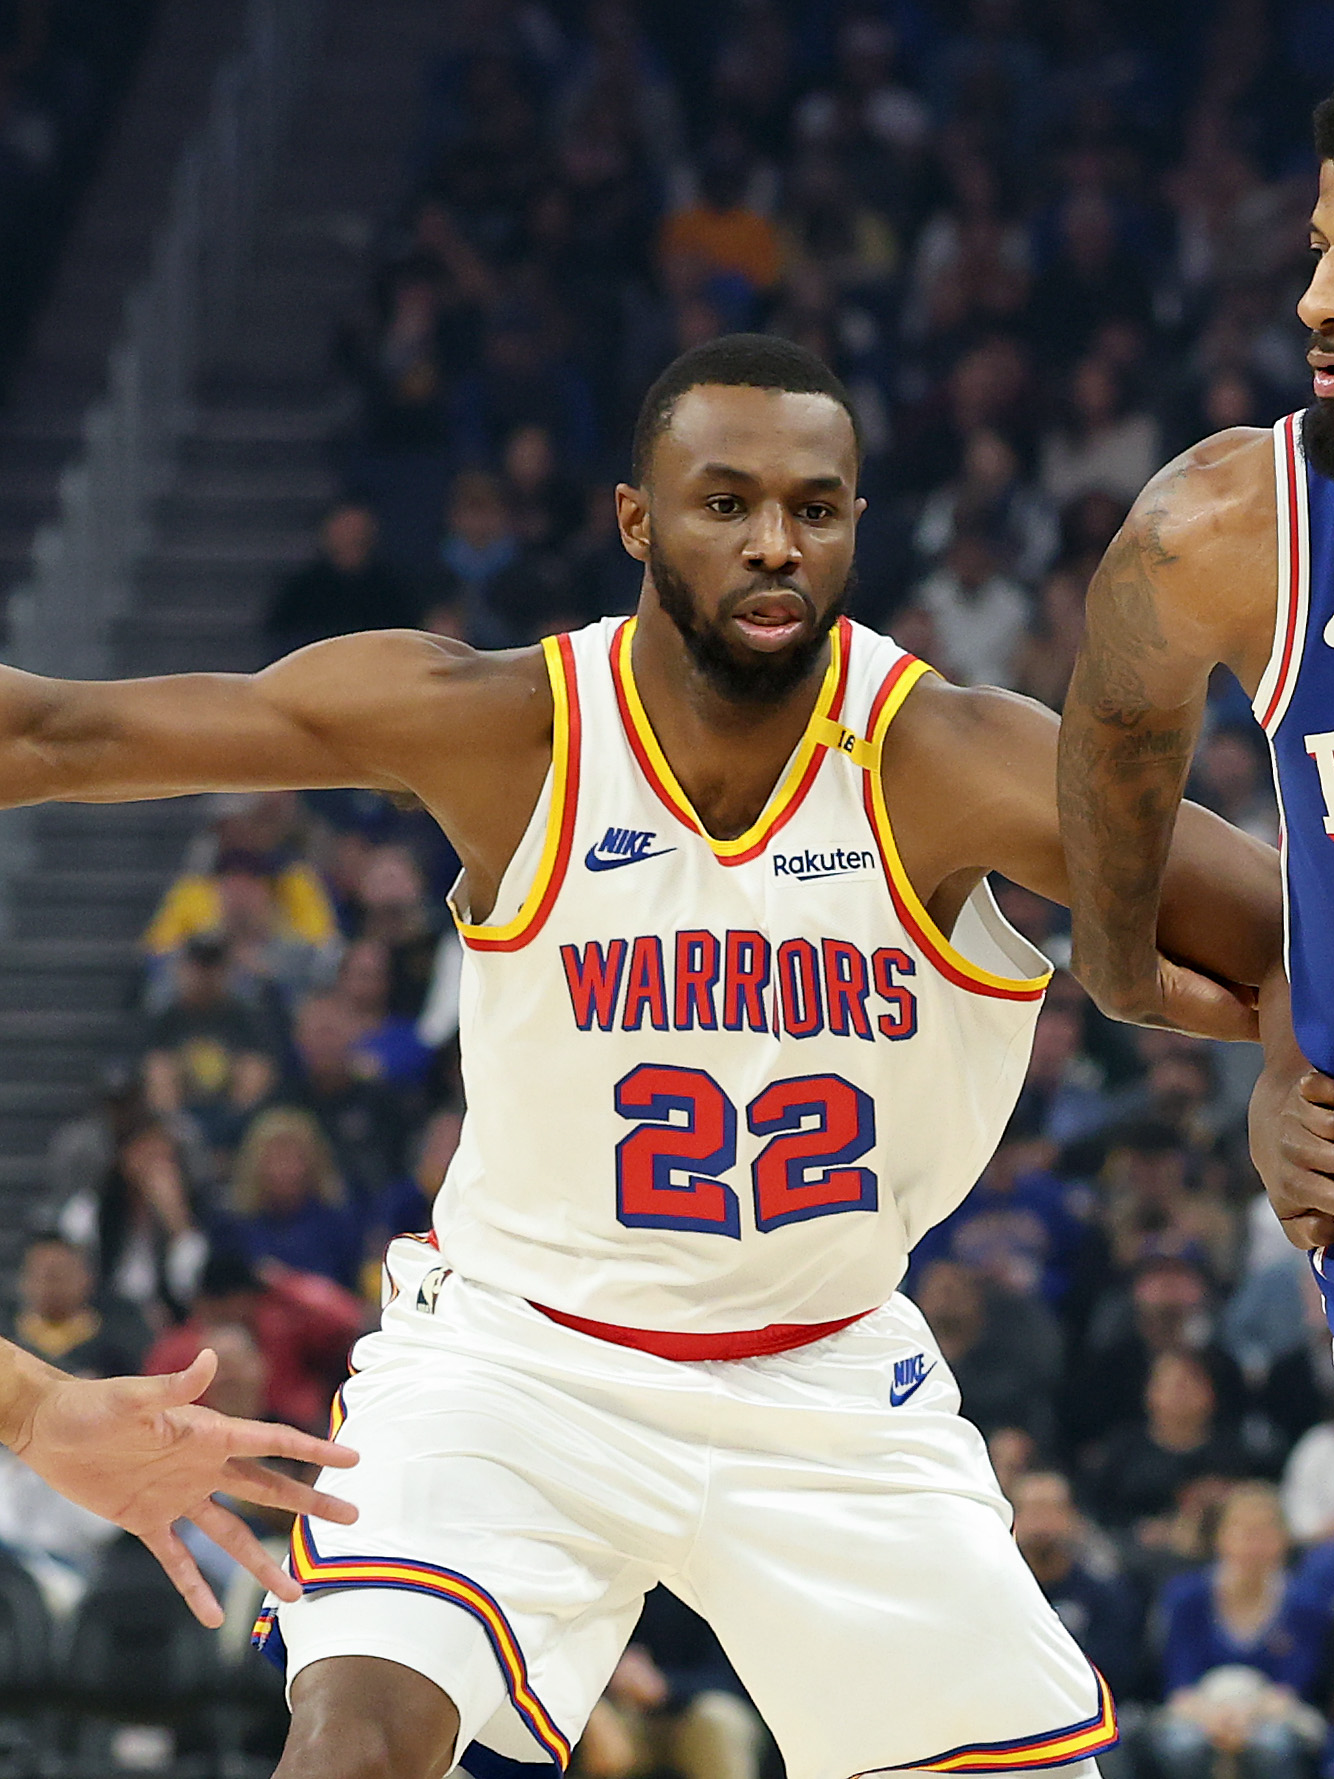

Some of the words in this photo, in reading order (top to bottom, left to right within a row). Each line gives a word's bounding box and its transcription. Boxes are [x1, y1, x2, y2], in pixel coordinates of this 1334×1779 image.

[599, 827, 657, 857] NIKE
[773, 848, 875, 877] Rakuten
[614, 1062, 878, 1241] 22
[894, 1353, 926, 1389] NIKE
